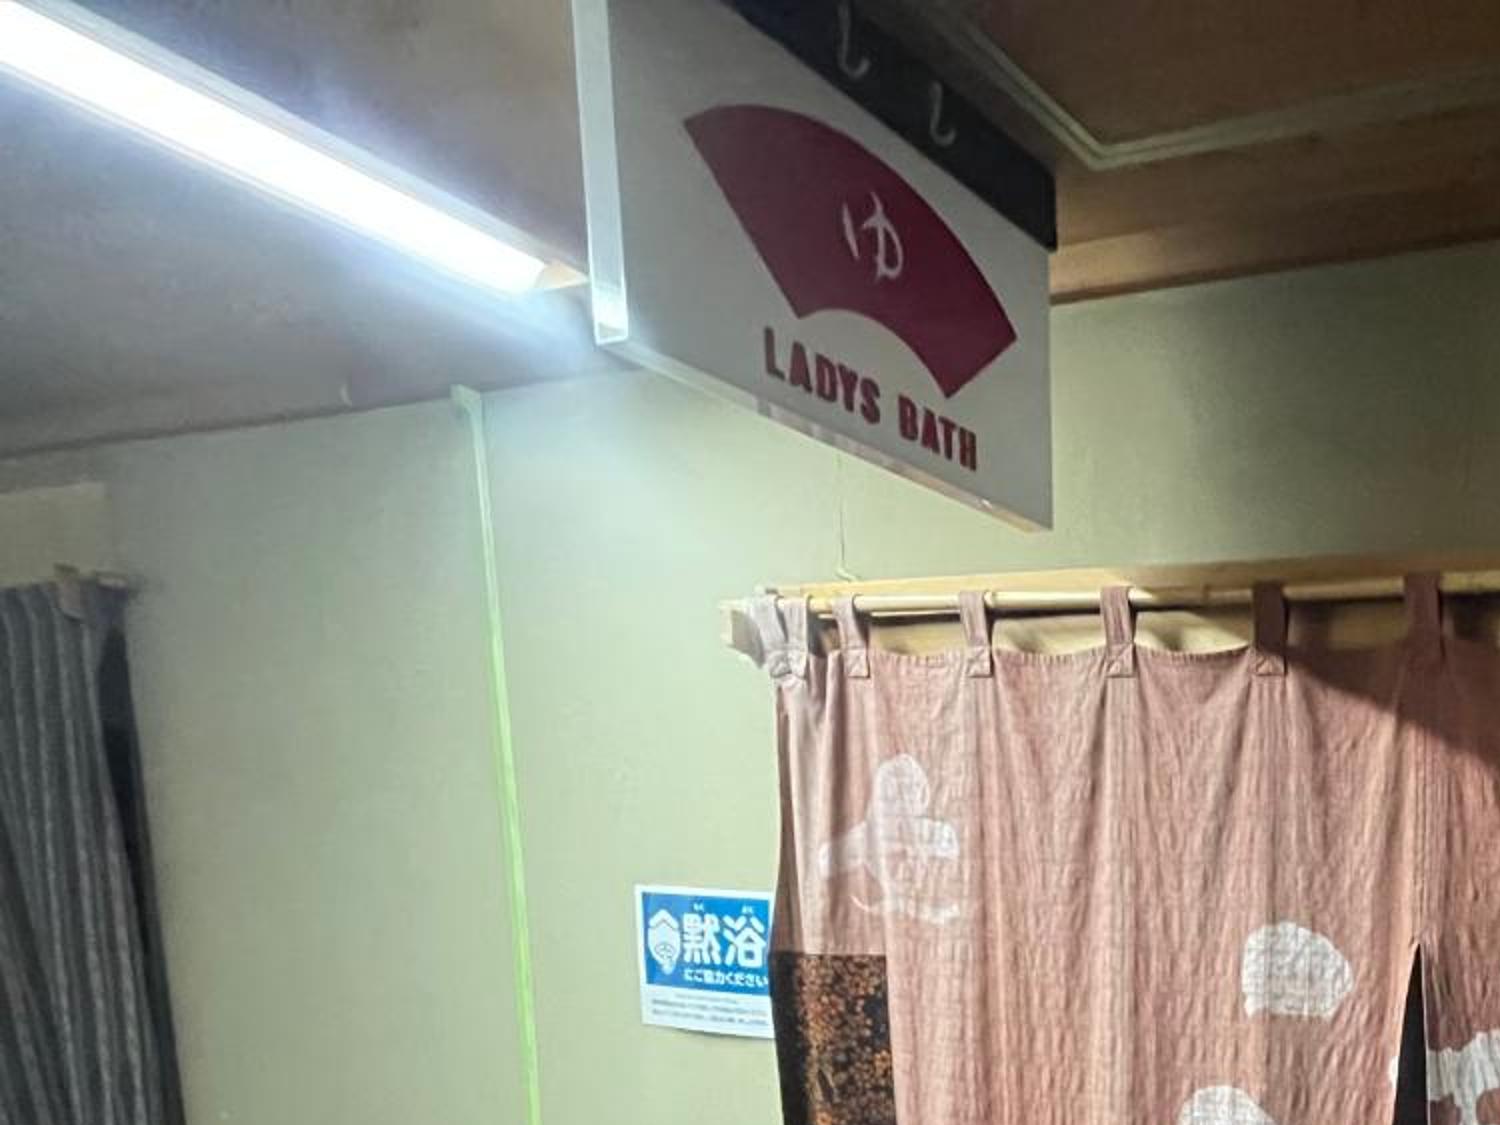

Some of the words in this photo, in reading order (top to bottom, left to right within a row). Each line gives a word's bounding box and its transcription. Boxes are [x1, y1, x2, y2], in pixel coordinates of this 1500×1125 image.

[842, 190, 905, 283] ゆ
[762, 326, 882, 426] LADYS
[897, 393, 979, 472] BATH
